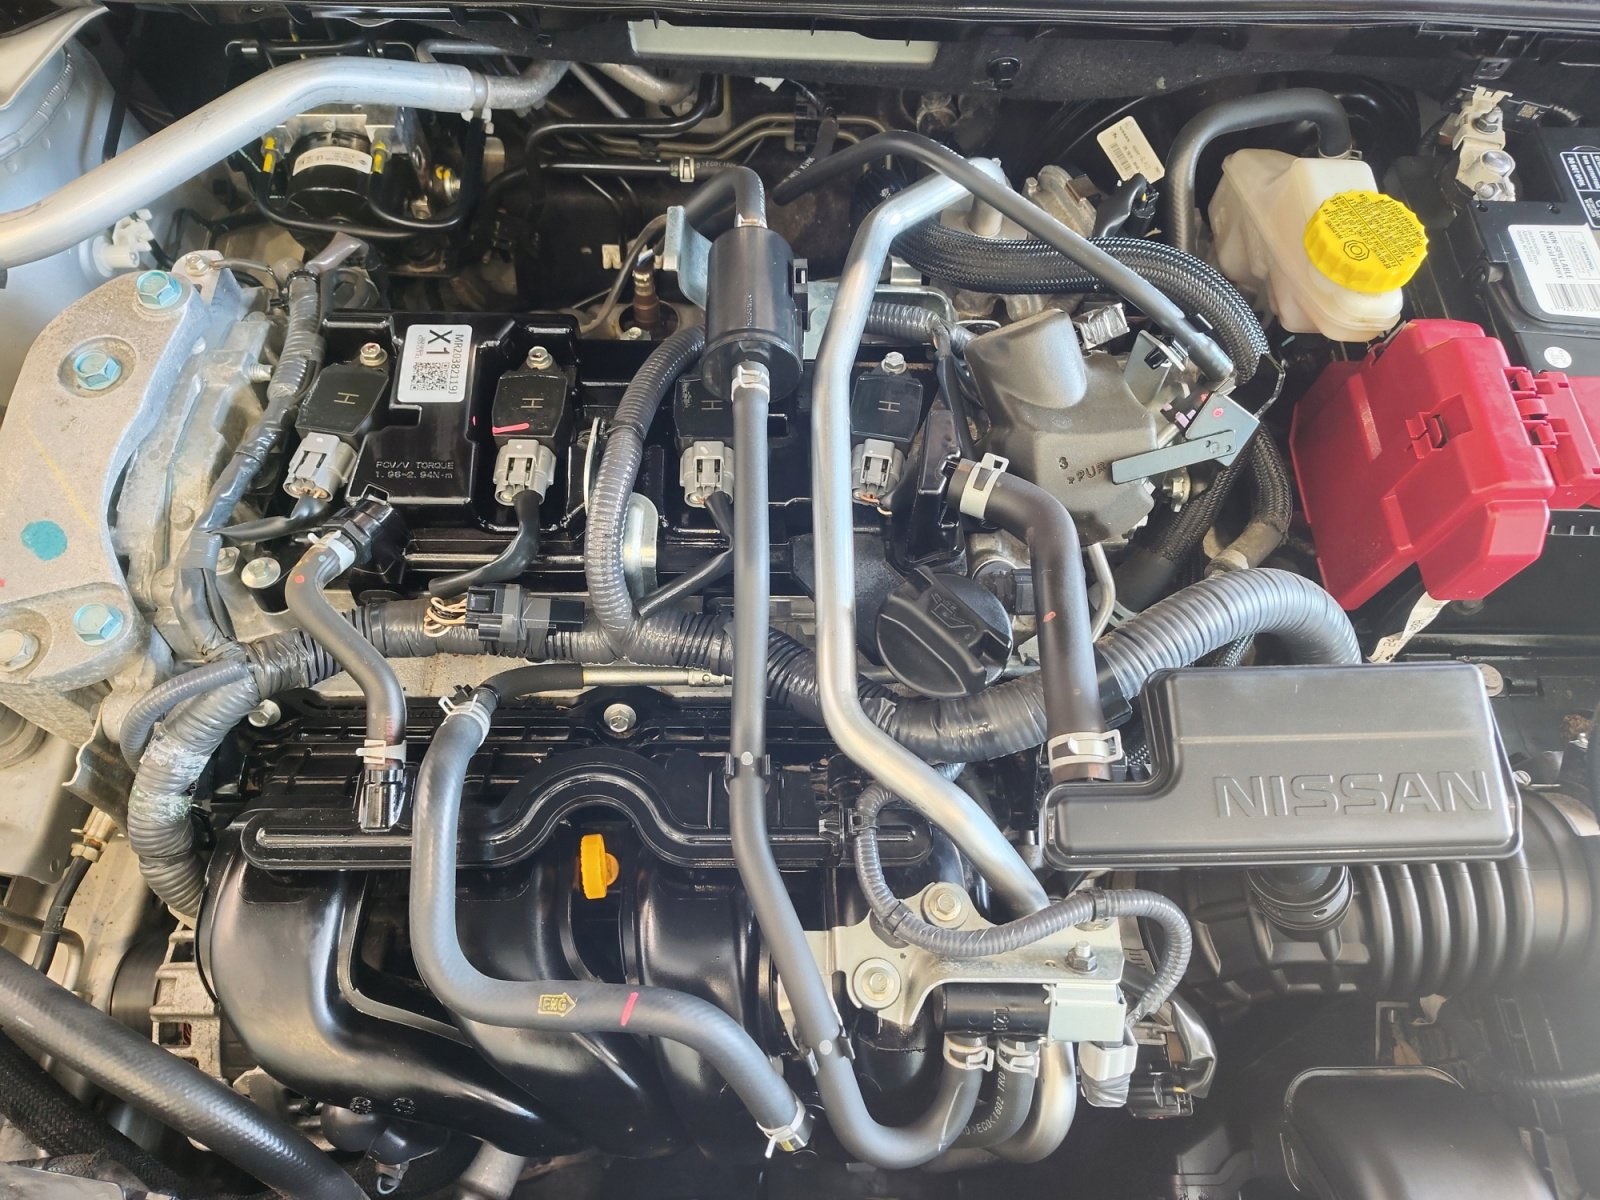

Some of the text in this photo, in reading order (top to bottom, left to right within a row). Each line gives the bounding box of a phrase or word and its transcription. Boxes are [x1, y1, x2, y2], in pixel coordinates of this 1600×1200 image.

[426, 329, 453, 355] X1
[416, 461, 455, 470] TORQUE
[1213, 770, 1492, 817] NISSAN
[542, 997, 567, 1011] ENG
